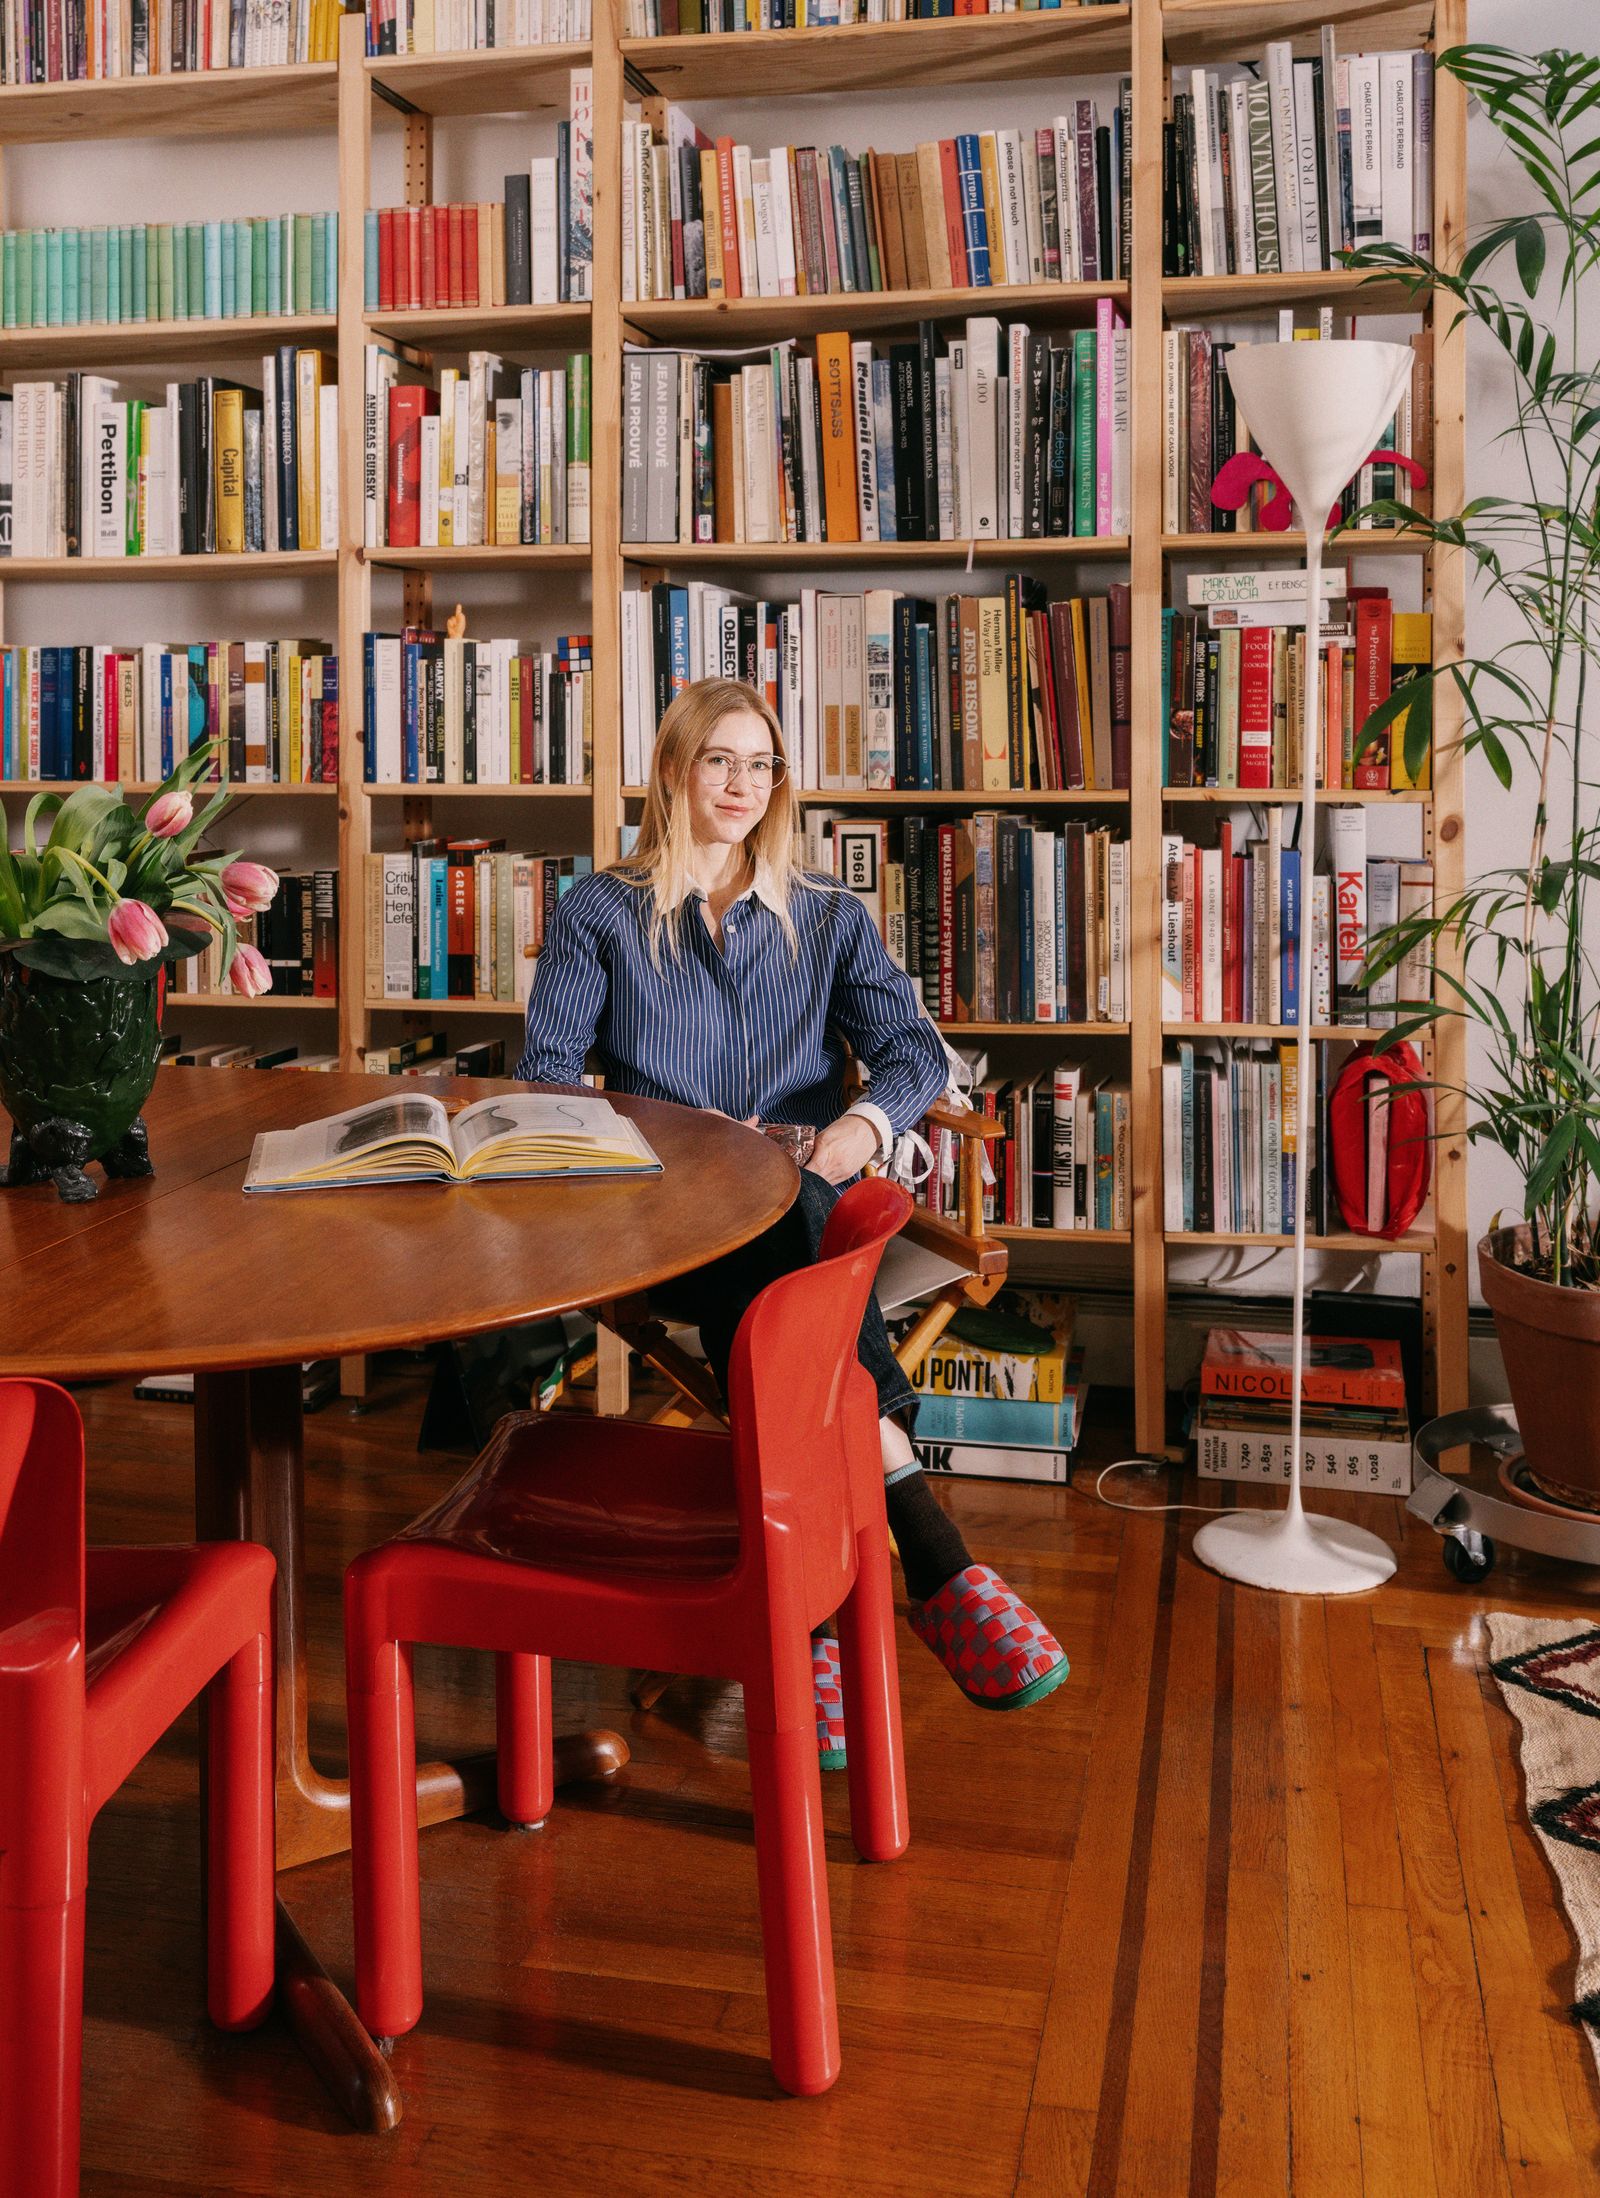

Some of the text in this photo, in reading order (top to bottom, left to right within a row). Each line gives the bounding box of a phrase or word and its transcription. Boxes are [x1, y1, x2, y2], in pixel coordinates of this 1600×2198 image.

[1059, 129, 1067, 153] Hella
[1123, 90, 1132, 178] Mary-Kate Olsen
[1364, 82, 1374, 171] CHARLOTTE PERRIAND
[1396, 80, 1404, 169] CHARLOTTE PERRIAND
[575, 86, 590, 224] HOKUSAI
[1060, 155, 1069, 202] Jongerius
[720, 152, 731, 223] HARRY BERTOIA
[1004, 142, 1020, 226] please do not touch
[1301, 137, 1318, 244] RENÉ PROU
[758, 194, 771, 235] Toogood
[1123, 196, 1132, 265] Ashley Olsen
[1012, 330, 1021, 347] Roy
[1099, 308, 1108, 419] BARBIE DREAMHOUSE
[905, 361, 914, 408] MODERN TASTE
[922, 370, 931, 413] SOTTSASS
[977, 368, 988, 404] at 100
[1014, 347, 1022, 384] McMakin
[629, 363, 643, 468] JEAN PROUVÉ
[656, 362, 670, 468] JEAN PROUVÉ
[829, 359, 843, 439] SOTTSASS
[1014, 388, 1022, 410] When
[282, 401, 293, 465] DE CHIRICO
[367, 394, 376, 500] ANDREAS GURSKY
[857, 361, 874, 512] Wendell Castle
[925, 435, 934, 479] CERAMICS
[1014, 427, 1022, 446] chair
[1082, 377, 1092, 508] HOW TO LIVE WITH OBJECTS
[101, 424, 117, 515] Pettibon
[221, 448, 239, 497] Capital
[397, 443, 405, 504] Untranslatables
[1014, 470, 1022, 495] chair?
[1202, 587, 1259, 601] FOR LUCIA
[1203, 575, 1256, 589] MAKE WAY
[790, 634, 798, 690] Art Deco Interiors
[982, 609, 992, 676] A Way of Living
[994, 609, 1002, 674] Herman Miller
[435, 662, 444, 701] HARVEY
[963, 627, 978, 741] JENS RISOM
[1115, 652, 1125, 719] MAXIME OLD
[1196, 642, 1206, 703] MOSH POTATOES
[436, 716, 444, 754] GLOBAL
[386, 883, 411, 896] Life,
[852, 844, 865, 883] 1968
[315, 873, 333, 918] BEHEMOTH
[435, 879, 444, 907] Latin:
[455, 870, 465, 916] GREEK
[894, 883, 902, 906] Mercer
[1087, 892, 1095, 935] HERALDRY
[1168, 843, 1178, 962] Atelier Van Lieshout
[1338, 872, 1364, 961] Kartell
[302, 891, 312, 959] KARL MARX CAPITAL
[895, 913, 905, 958] Furniture
[908, 867, 922, 973] Symbolic Architecture
[942, 834, 953, 1016] MÄRTA MÅÅS-FJETTERSTRÖM
[1185, 897, 1193, 994] ATELIER VAN LIESHOUT
[1055, 1083, 1073, 1101] NW
[1183, 1069, 1192, 1134] PAINT MAGIC
[1284, 1066, 1297, 1136] ARTY PARTIES
[1054, 1116, 1072, 1188] ZADIE SMITH
[930, 1358, 991, 1393] PONTI
[1241, 1443, 1249, 1469] 1,740
[1262, 1444, 1271, 1472] 2,852
[1306, 1452, 1316, 1472] 237
[1327, 1454, 1336, 1474] 546
[1349, 1456, 1358, 1476] 565
[1370, 1454, 1379, 1481] 1,028
